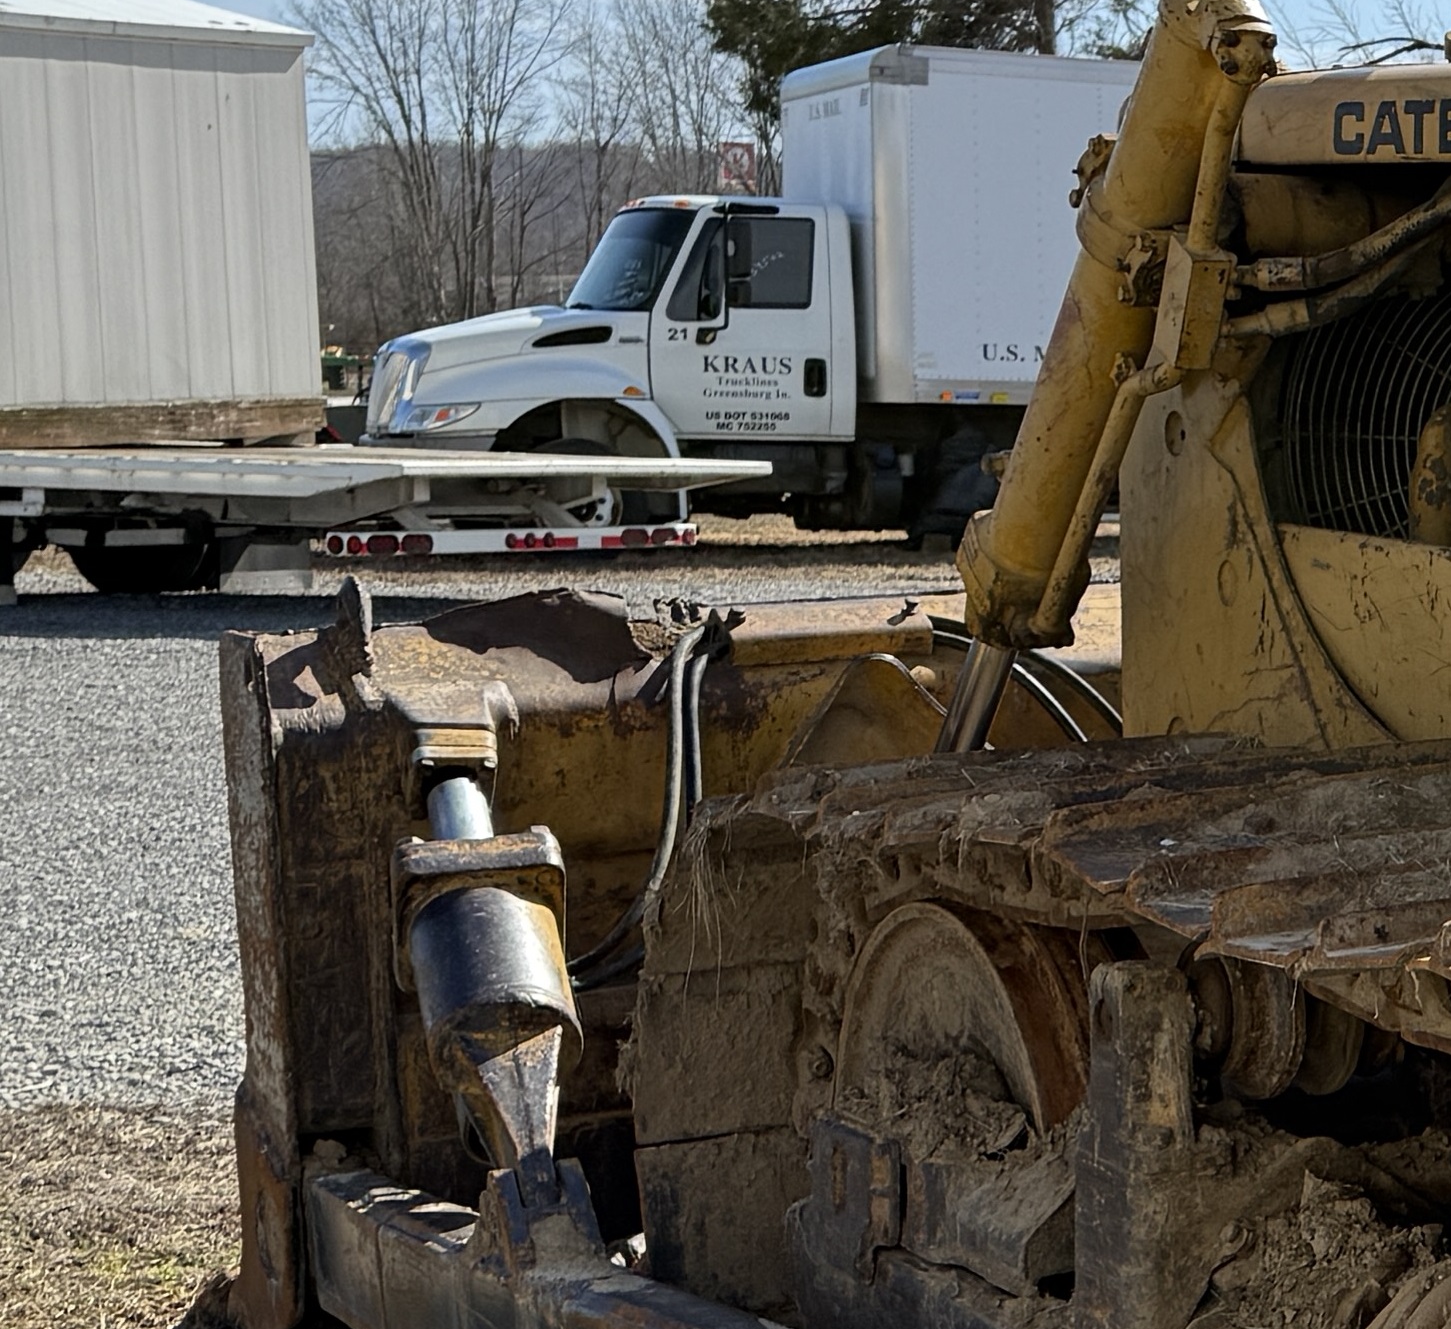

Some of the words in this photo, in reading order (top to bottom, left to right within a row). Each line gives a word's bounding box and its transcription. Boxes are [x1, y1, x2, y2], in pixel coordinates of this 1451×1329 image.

[667, 327, 689, 342] 21
[982, 343, 1026, 362] U.S.
[702, 354, 793, 375] KRAUS
[716, 376, 779, 387] Trucklines
[702, 387, 772, 400] Greensburg
[705, 411, 721, 421] US
[724, 411, 748, 421] DOT
